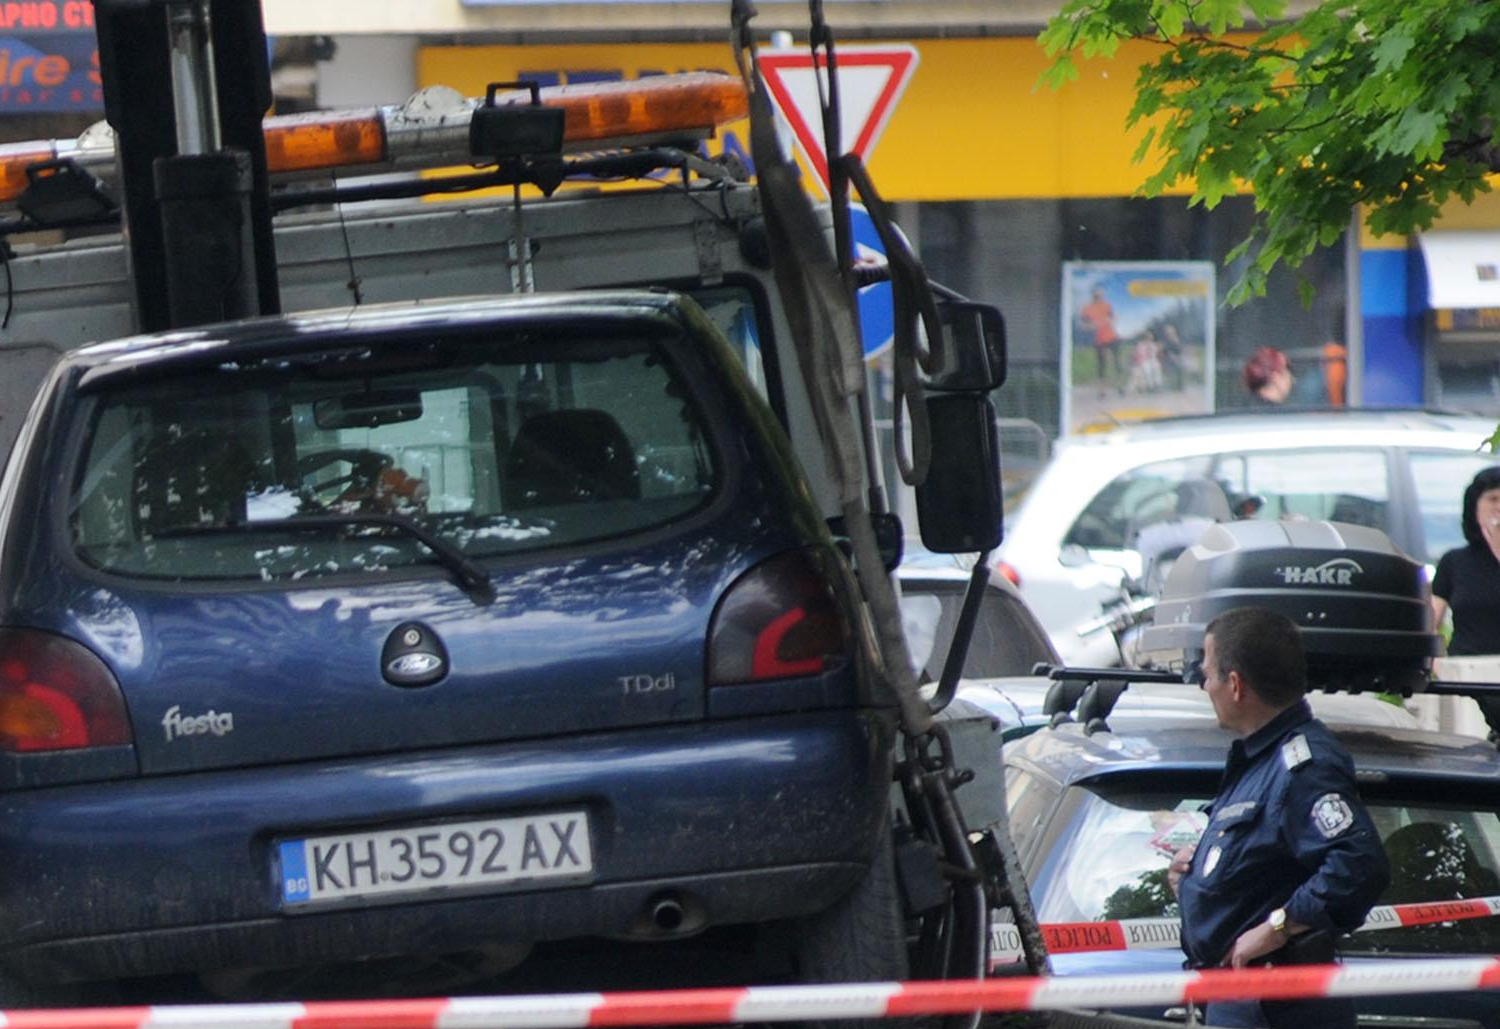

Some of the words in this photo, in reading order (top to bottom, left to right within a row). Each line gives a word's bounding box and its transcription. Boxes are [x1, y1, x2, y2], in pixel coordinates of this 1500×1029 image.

[1284, 566, 1352, 584] HAKR
[162, 704, 233, 741] fiesta
[1050, 926, 1112, 949] POLICE
